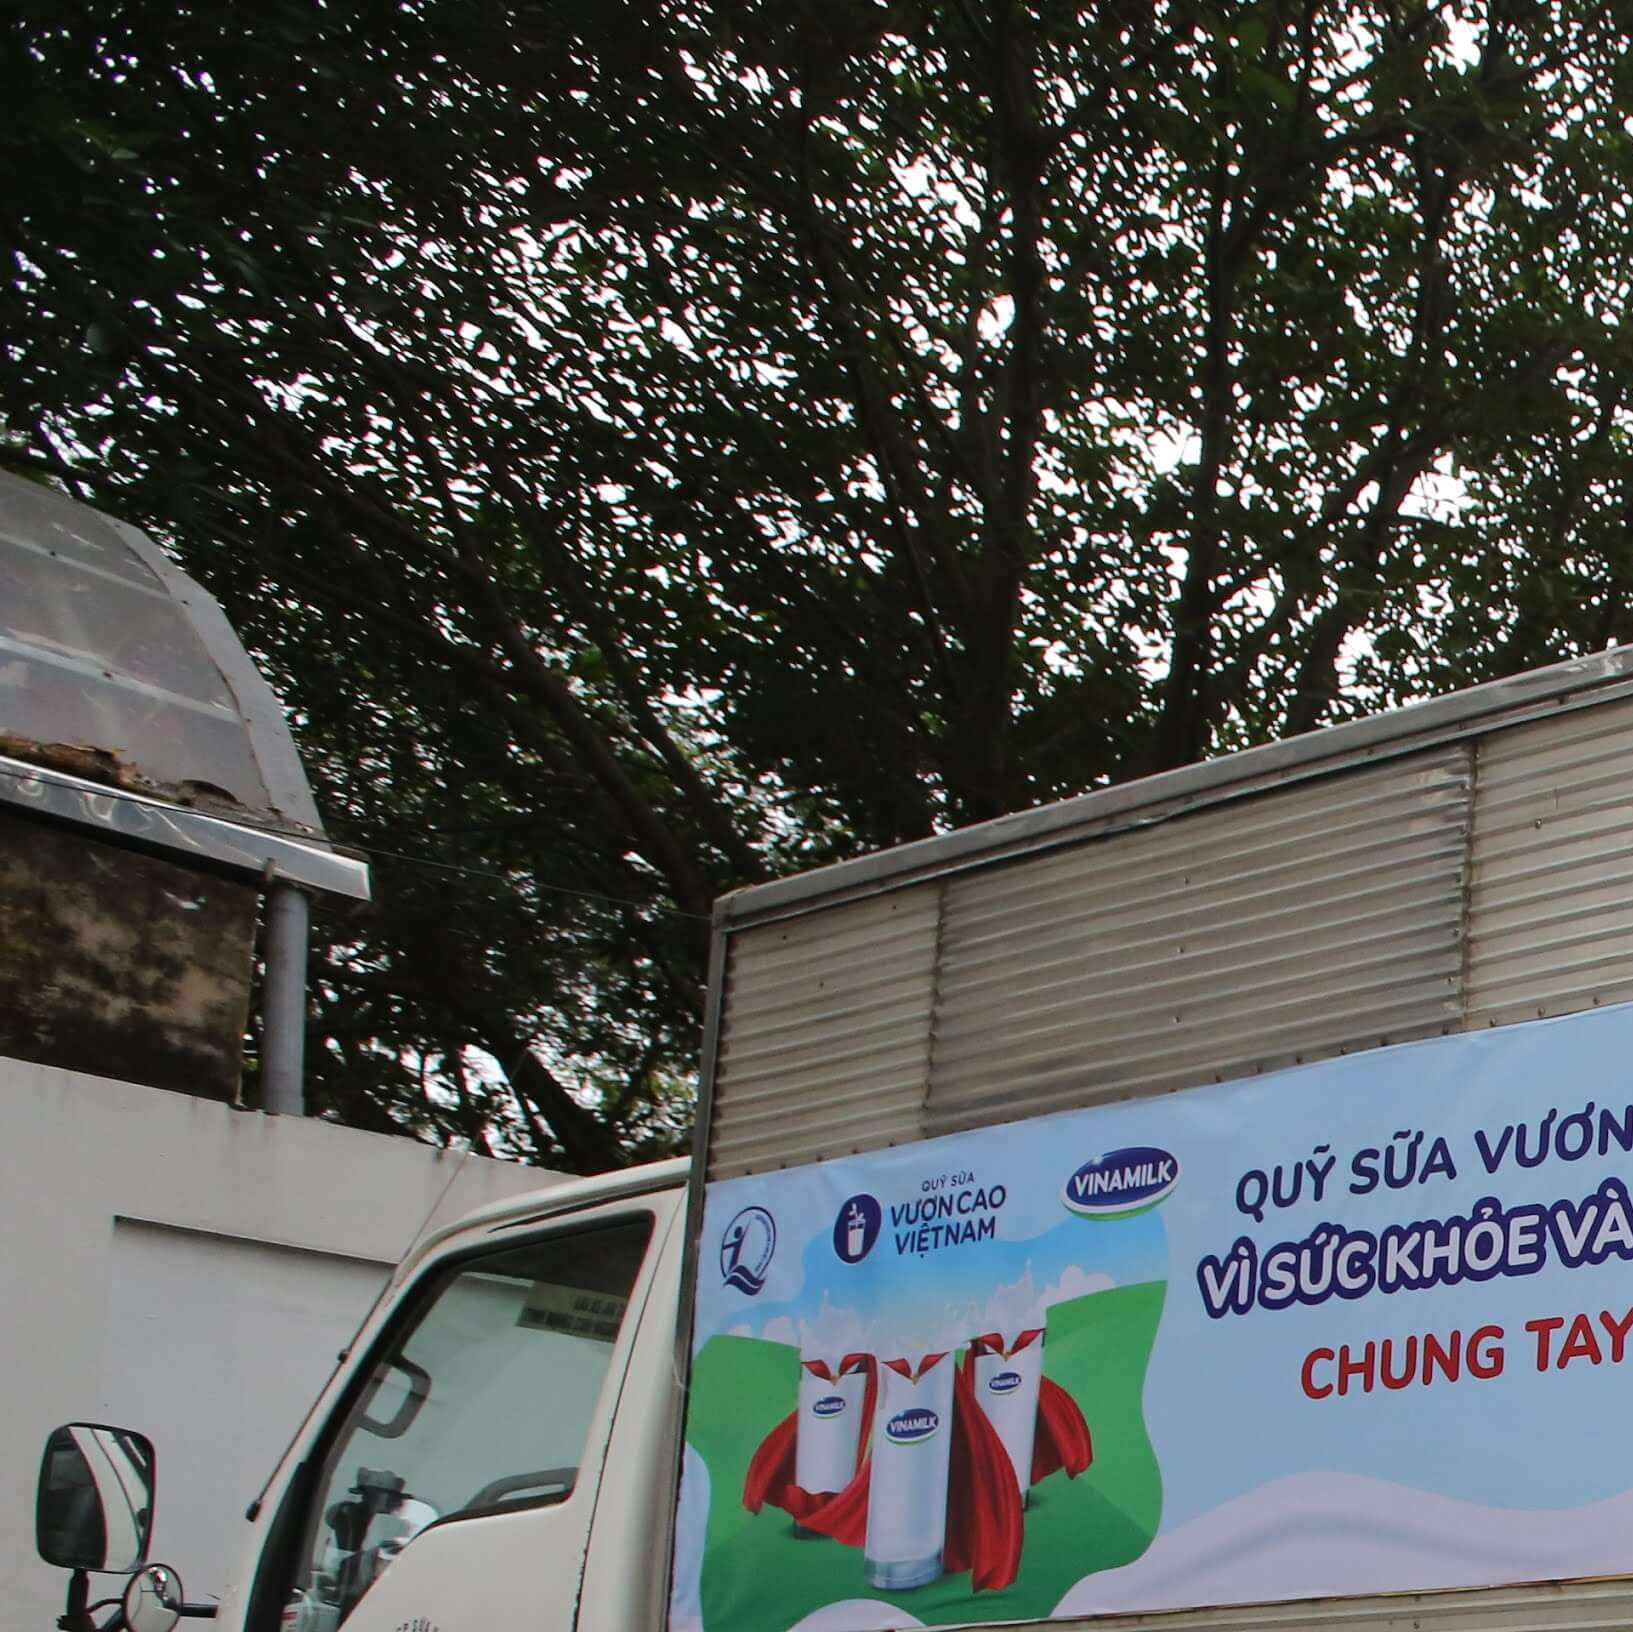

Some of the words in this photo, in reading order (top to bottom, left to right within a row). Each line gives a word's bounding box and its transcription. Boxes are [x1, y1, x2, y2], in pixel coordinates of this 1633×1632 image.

[1073, 1159, 1173, 1197] VINAMILK
[1236, 1144, 1336, 1223] QUỸ
[1349, 1130, 1457, 1194] SỮA
[1201, 1241, 1254, 1314] VÌ
[1262, 1227, 1372, 1305] SỨC
[1382, 1202, 1543, 1288] KHỎE
[1301, 1325, 1504, 1399] CHUNG
[889, 1416, 937, 1432] VINAMILK
